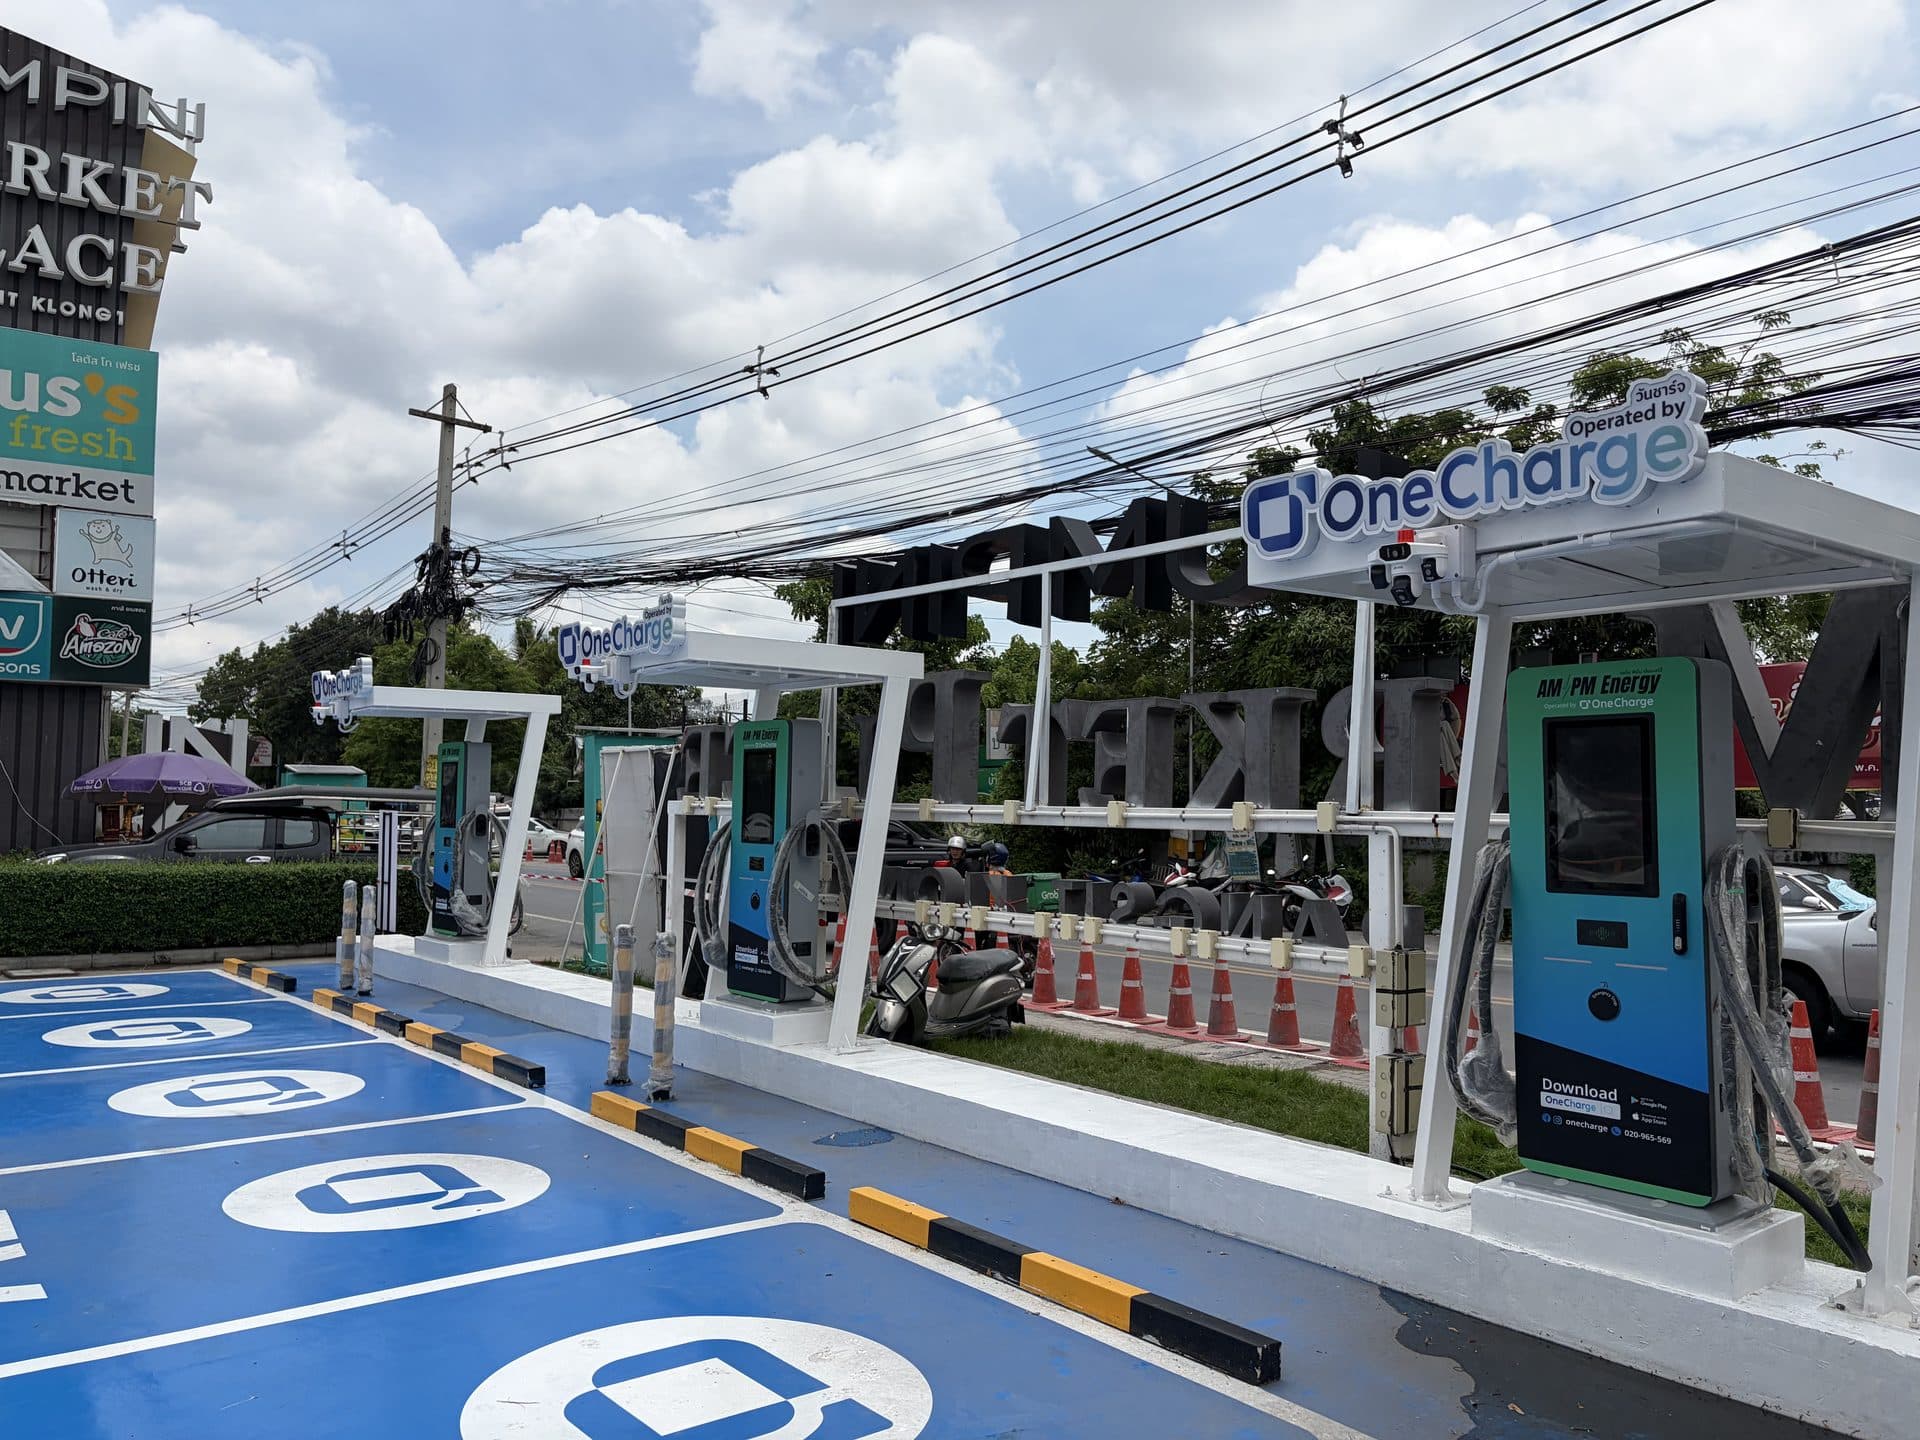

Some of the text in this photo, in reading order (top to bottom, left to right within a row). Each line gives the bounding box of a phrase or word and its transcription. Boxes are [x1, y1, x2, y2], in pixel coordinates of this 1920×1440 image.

[0, 140, 213, 230] RKET
[0, 223, 164, 294] ACE
[1636, 380, 1686, 402] วันชาร์จ
[1569, 400, 1686, 438] Operated by
[9, 414, 136, 462] fresh
[0, 468, 135, 504] market
[1323, 425, 1687, 532] OneCharge
[72, 567, 138, 588] Otteri
[582, 615, 673, 657] OneCharge
[1600, 674, 1661, 695] Energy
[1592, 697, 1654, 709] OneCharge
[1041, 889, 1059, 900] Grab
[1542, 1078, 1618, 1102] Download
[1545, 1095, 1596, 1112] OneCharge
[1565, 1118, 1608, 1133] onecharge
